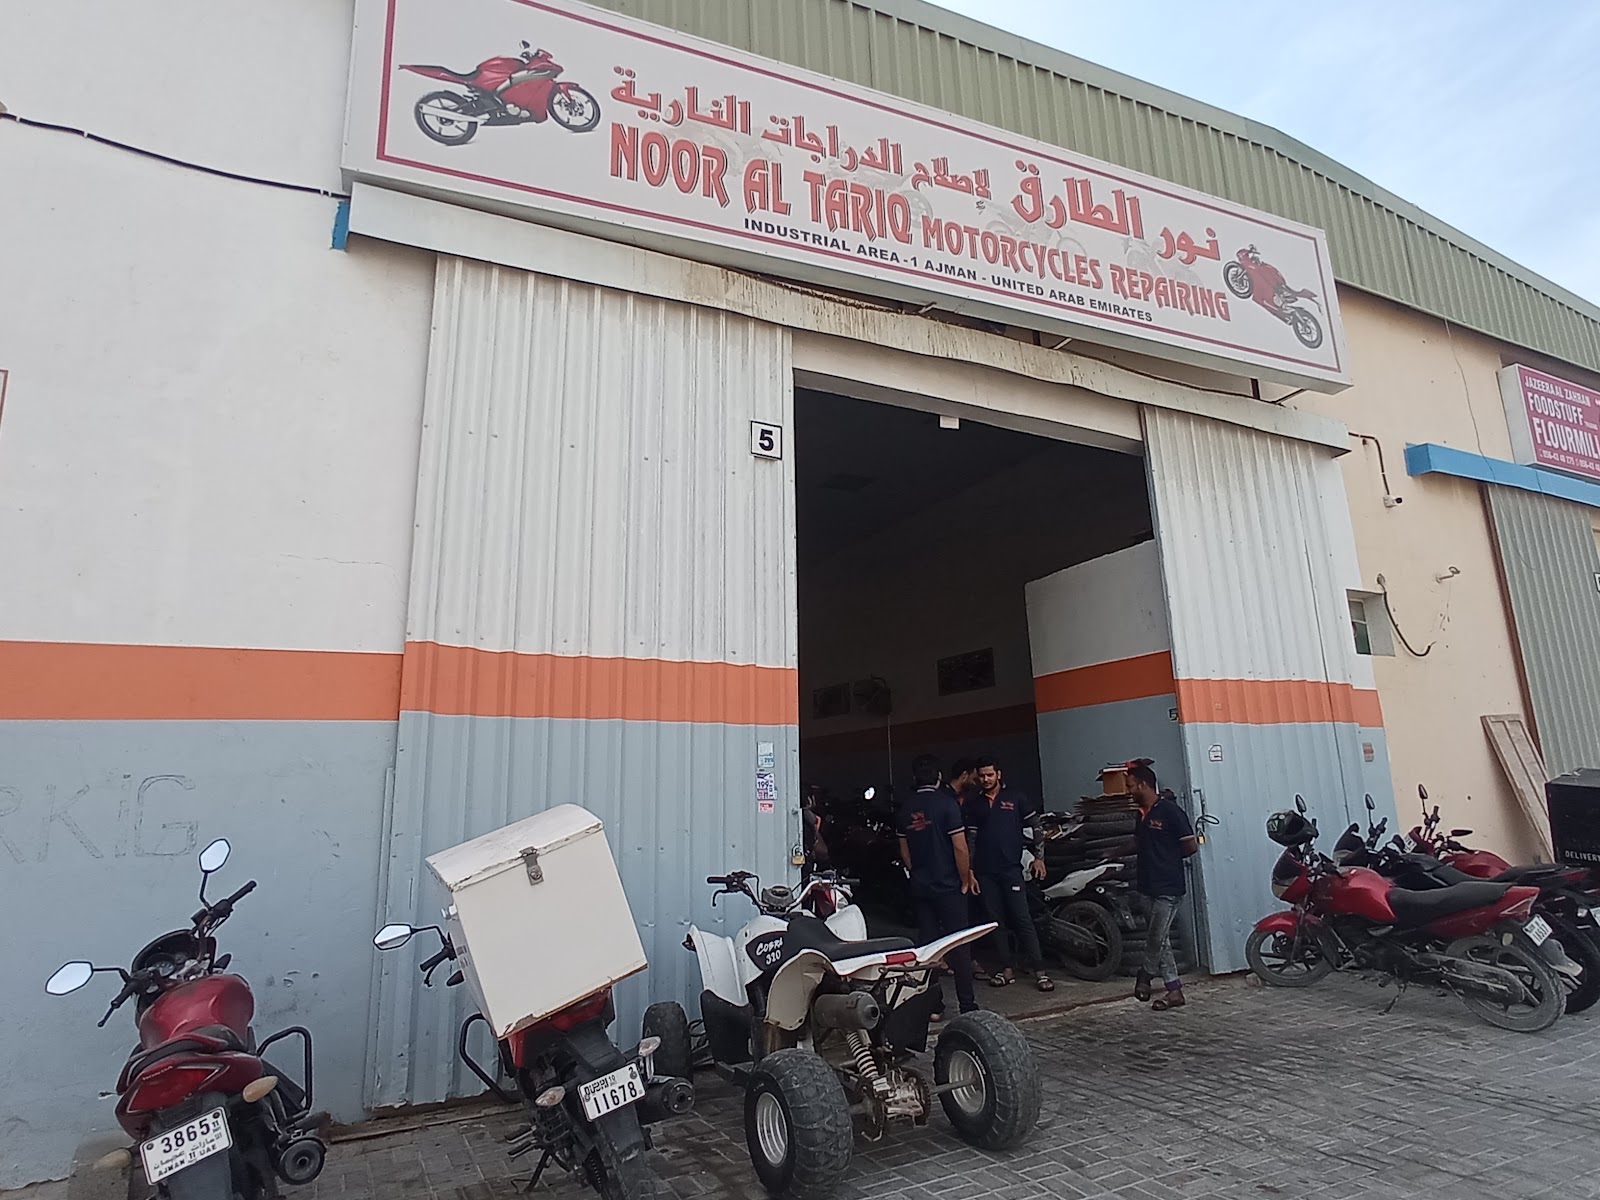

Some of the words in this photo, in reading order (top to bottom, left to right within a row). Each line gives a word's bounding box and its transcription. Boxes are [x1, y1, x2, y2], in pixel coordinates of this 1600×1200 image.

[610, 65, 752, 137] النارية
[761, 115, 903, 177] الدراجات
[1011, 160, 1144, 240] الطارق
[610, 122, 730, 208] NOOR
[743, 158, 791, 216] AL
[803, 170, 912, 246] TARIQ
[921, 215, 1104, 290] MOTORCYCLES
[1109, 263, 1231, 323] REPAIRING
[1156, 227, 1221, 266] نور
[744, 218, 850, 252] INDUSTRIAL
[856, 244, 900, 264] AREA
[925, 260, 977, 281] AJMAN
[991, 275, 1044, 297] UNITED
[1049, 289, 1086, 306] ARAB
[1089, 298, 1153, 322] EMIRATES
[1527, 392, 1584, 426] FOODSTUFF
[759, 428, 774, 452] 5
[593, 1081, 637, 1114] 11678
[161, 1118, 211, 1153] 3865
[199, 1143, 218, 1156] UAE
[158, 1158, 185, 1177] AJMAN
